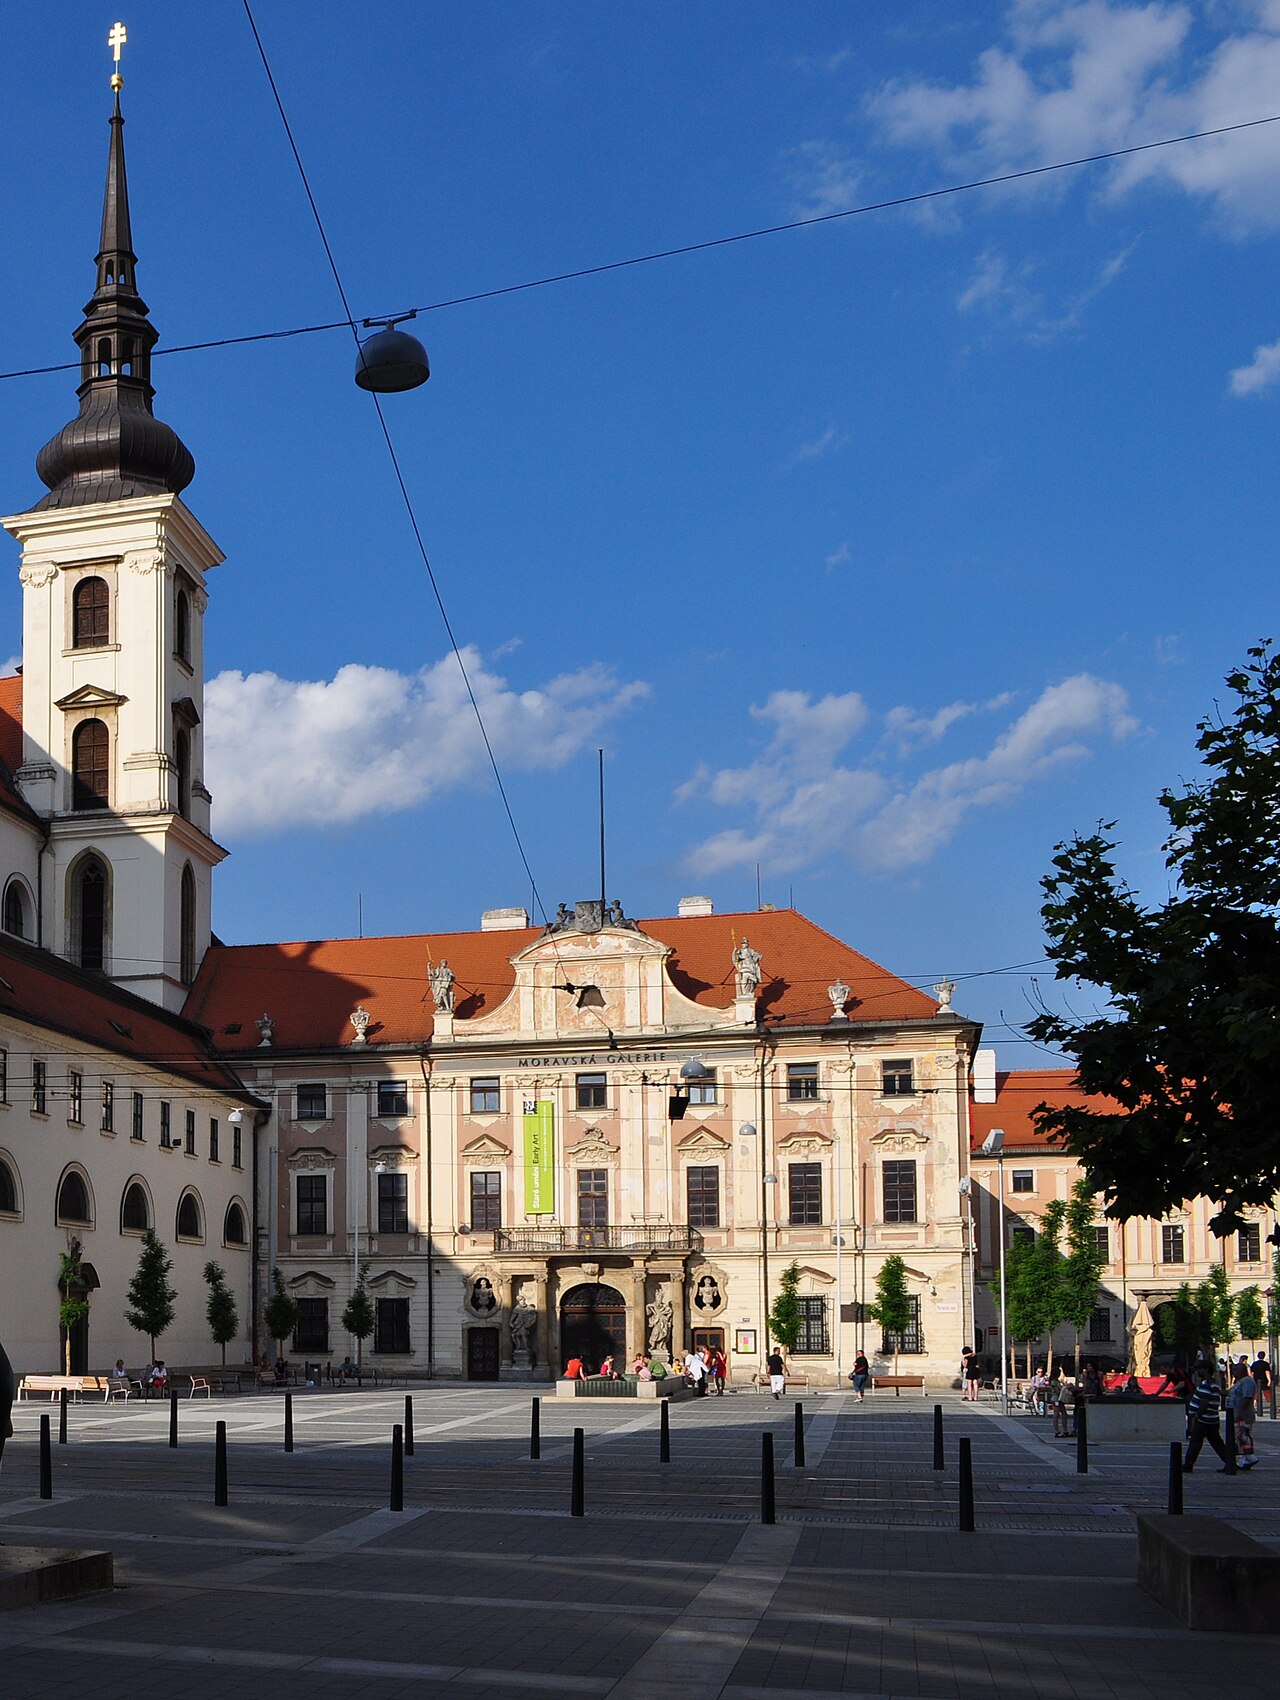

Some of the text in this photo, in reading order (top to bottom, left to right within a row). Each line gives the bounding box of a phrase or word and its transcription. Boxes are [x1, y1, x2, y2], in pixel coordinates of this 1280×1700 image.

[518, 1052, 667, 1068] MORAVSKÁ GALERIE
[532, 1146, 540, 1164] Early
[532, 1189, 540, 1209] Staré
